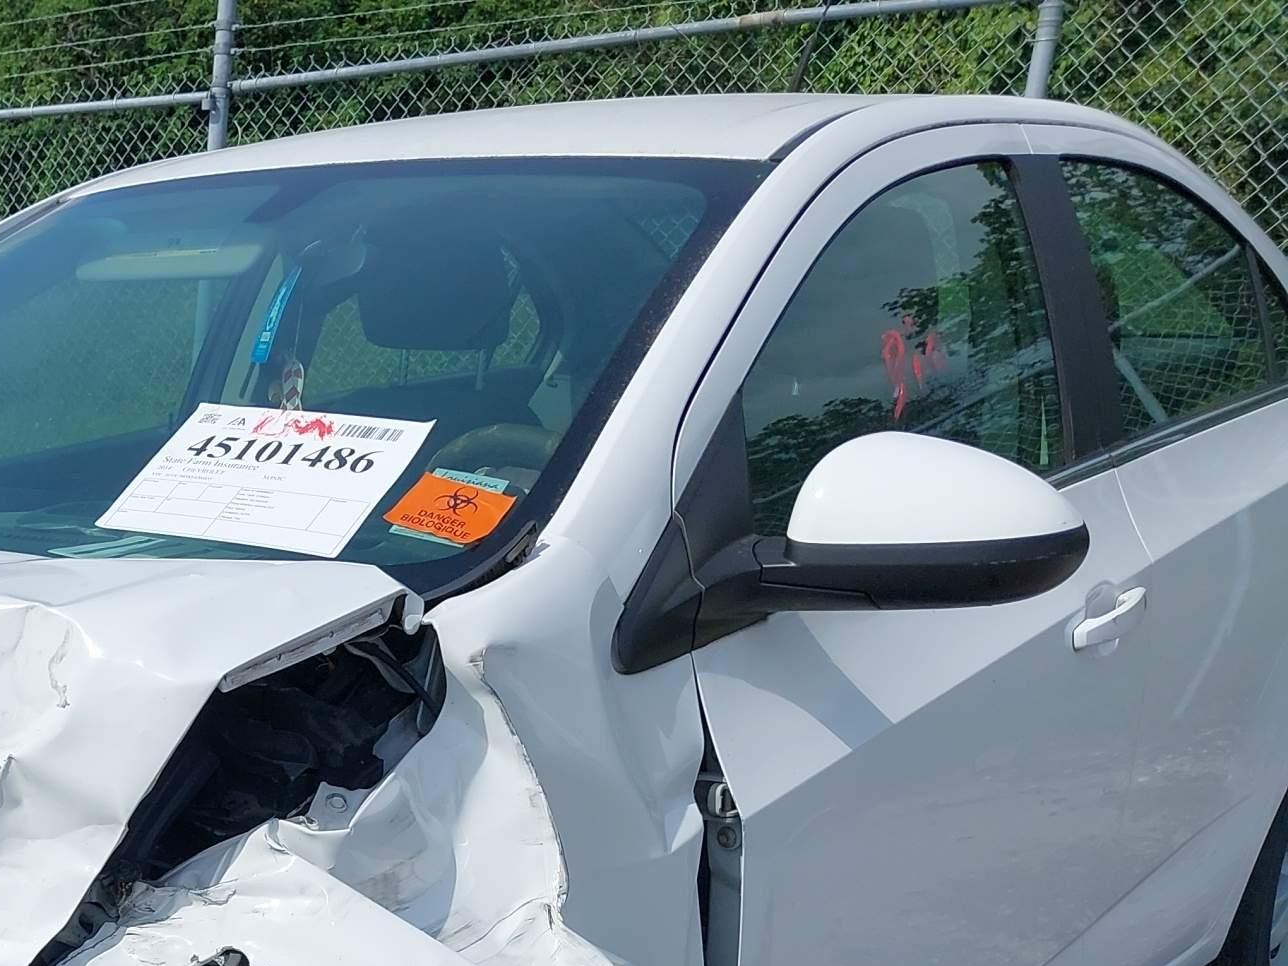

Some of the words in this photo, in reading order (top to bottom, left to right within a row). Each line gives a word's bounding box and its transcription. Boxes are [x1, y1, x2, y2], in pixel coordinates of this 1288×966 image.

[163, 455, 186, 466] State
[187, 457, 213, 467] Farm
[214, 460, 260, 471] Insurance
[188, 434, 384, 473] 45101486
[400, 513, 472, 540] BIOLOGIQUE
[417, 509, 466, 529] DANGER
